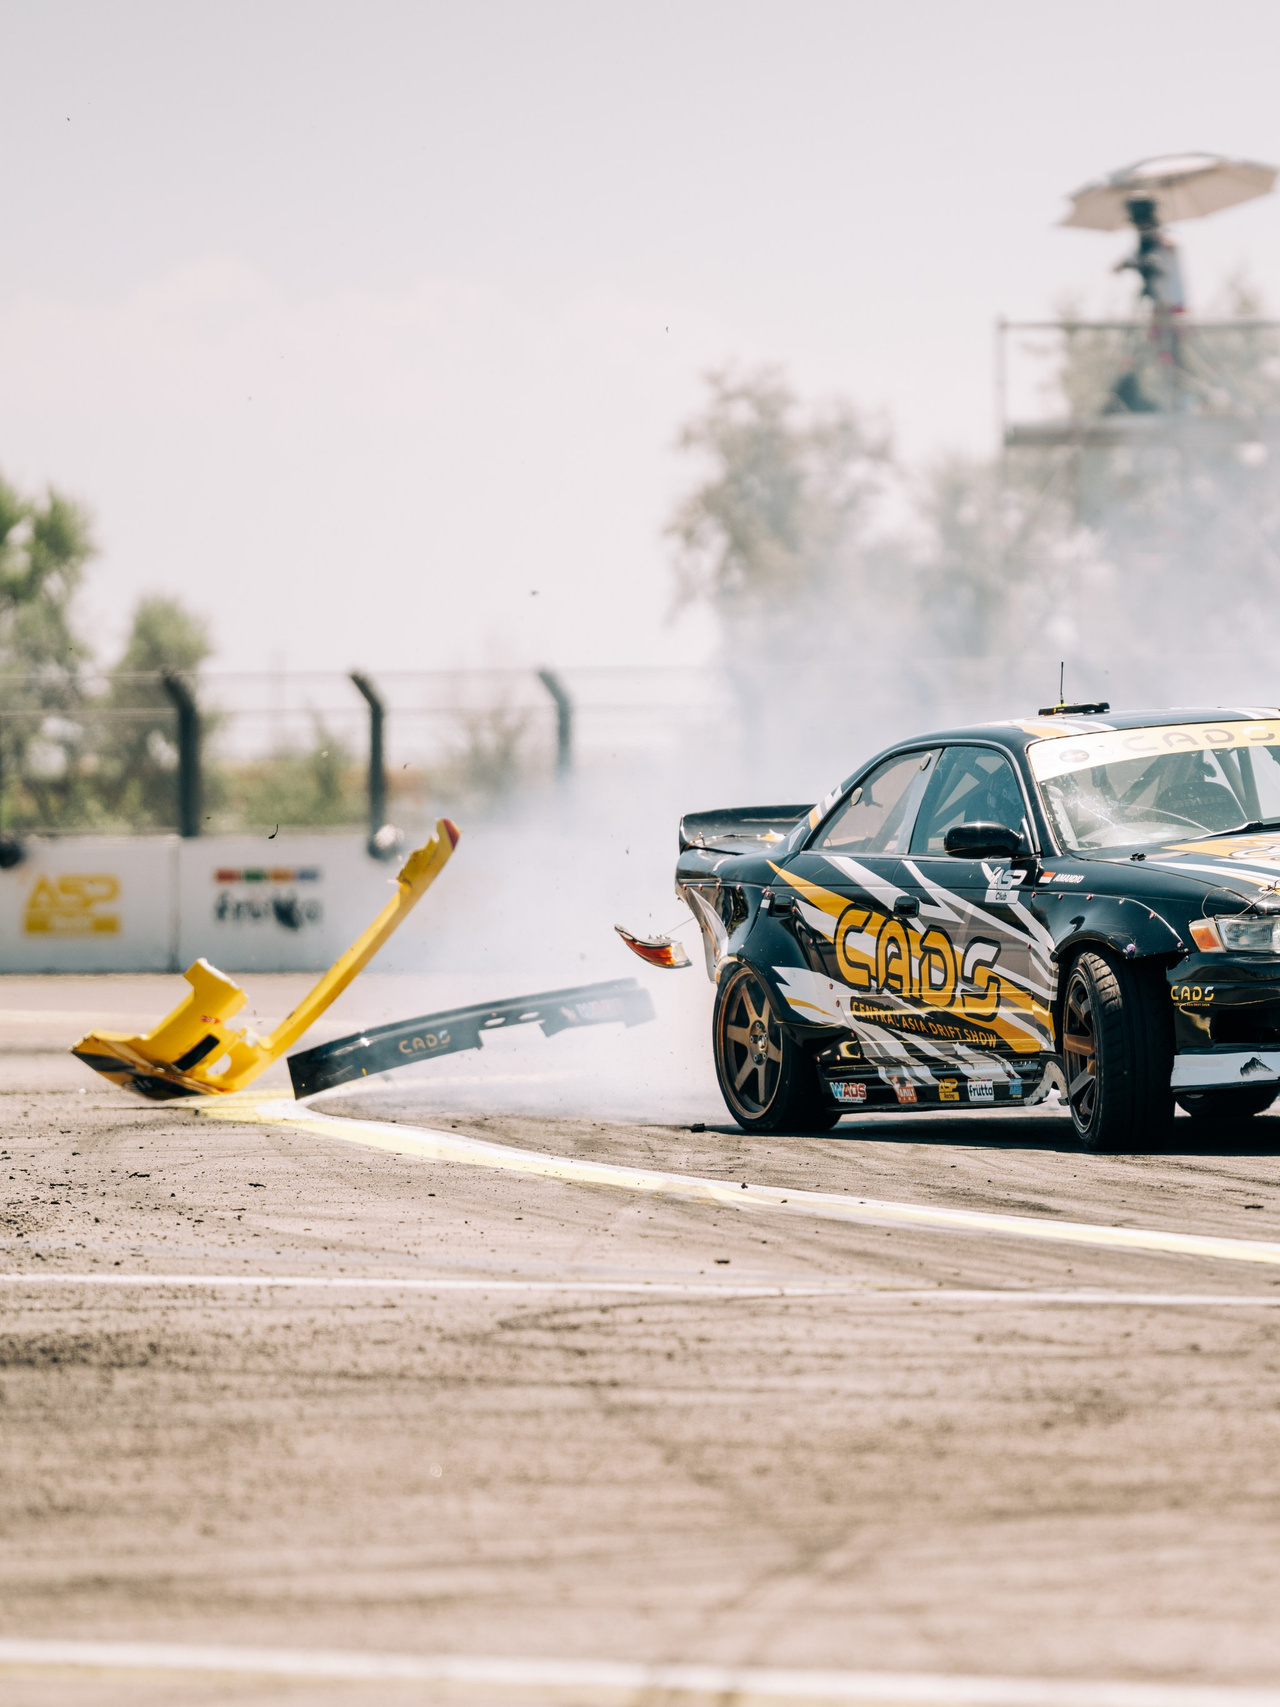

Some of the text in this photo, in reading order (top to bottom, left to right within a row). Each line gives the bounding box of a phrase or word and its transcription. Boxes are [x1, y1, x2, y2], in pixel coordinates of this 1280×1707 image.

[1123, 726, 1275, 751] CADS
[834, 906, 1001, 1021] CADS
[1170, 985, 1215, 1001] CADS
[851, 1001, 997, 1049] CENTRAL ASIA DRIFT SHOW
[399, 1030, 451, 1054] CADS
[830, 1082, 867, 1098] WADS
[968, 1084, 993, 1096] frütta
